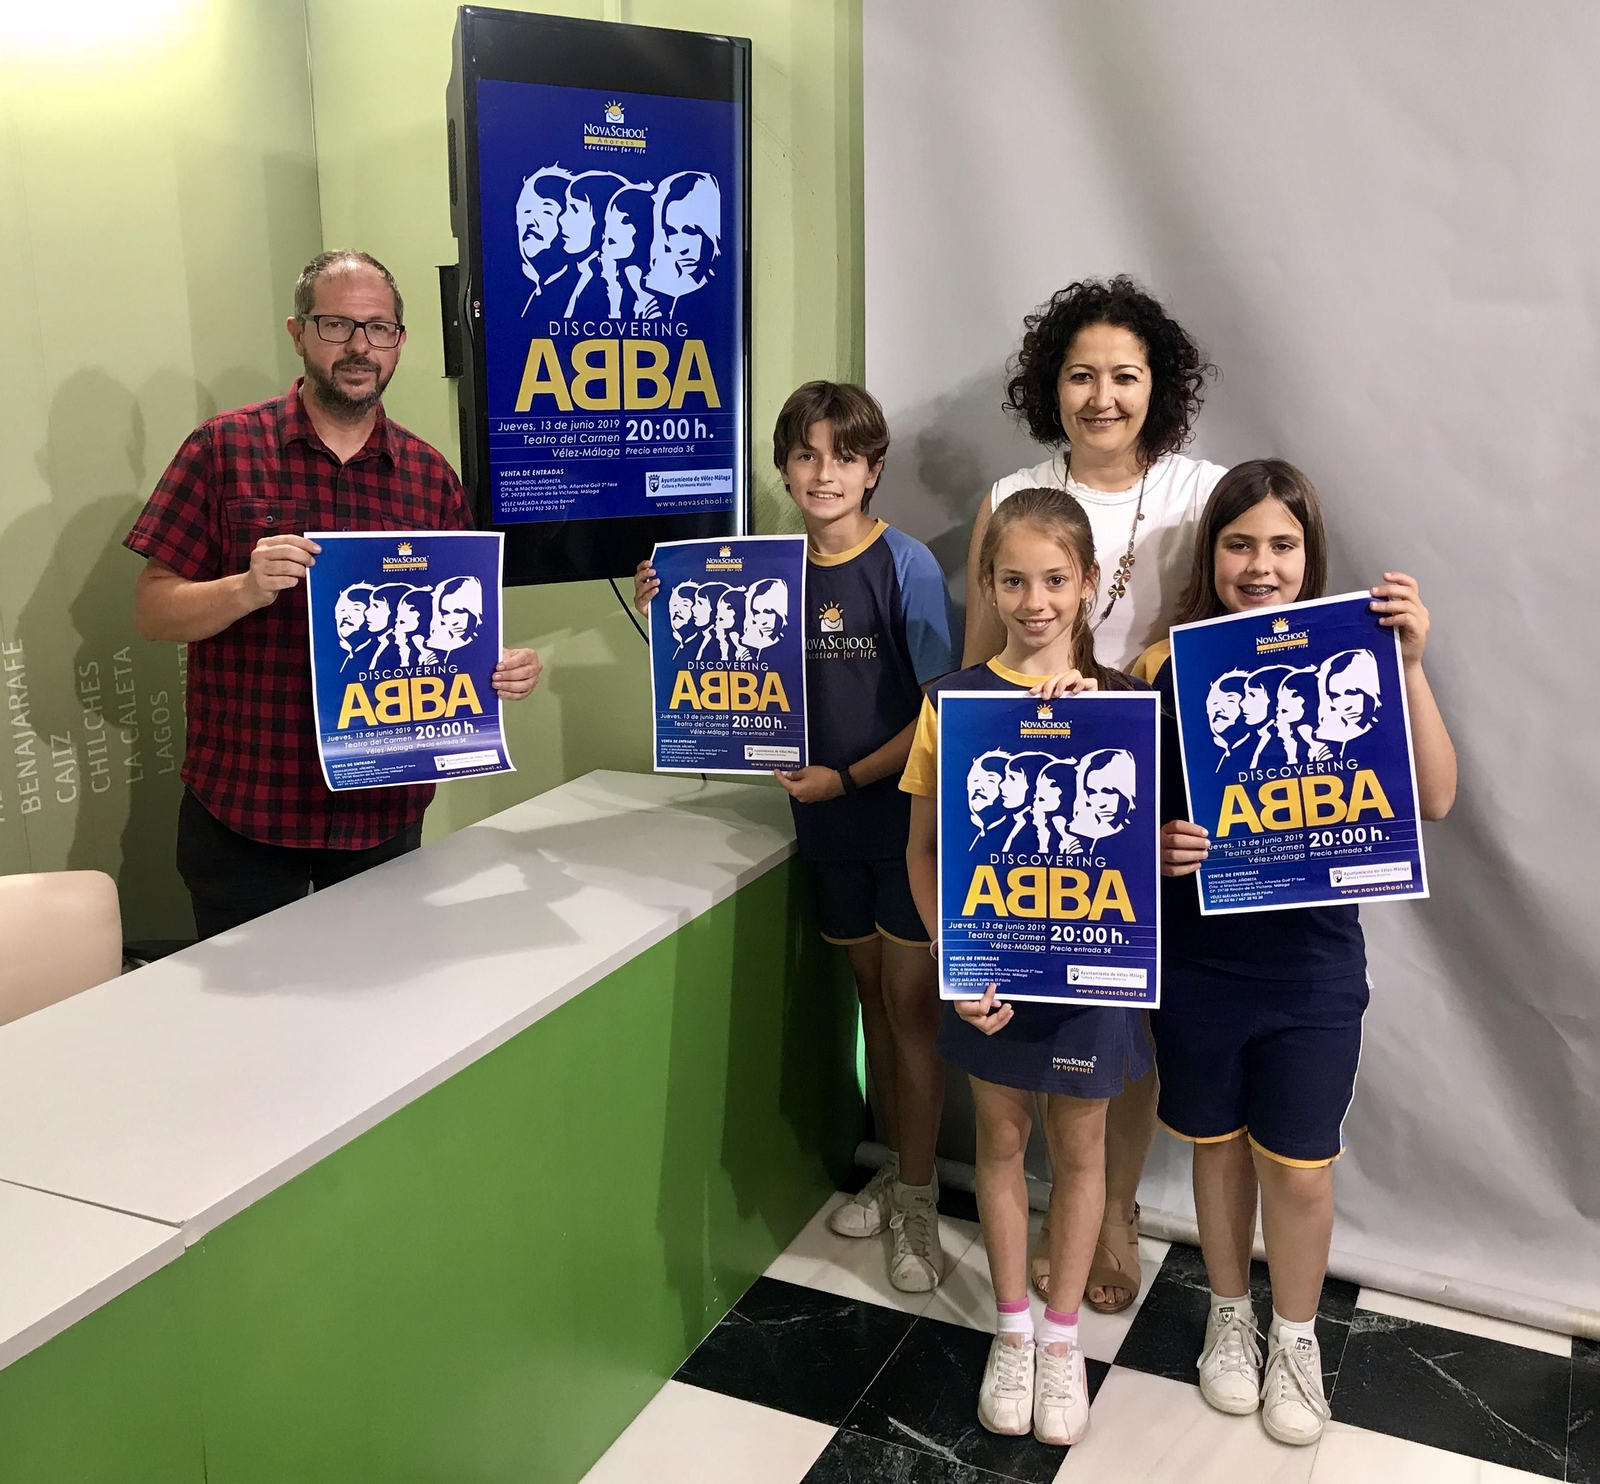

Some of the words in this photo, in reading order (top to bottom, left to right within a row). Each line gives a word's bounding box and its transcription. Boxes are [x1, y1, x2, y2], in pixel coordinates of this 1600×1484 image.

[584, 144, 618, 152] education
[621, 146, 632, 154] for
[550, 321, 689, 337] DISCOVERING
[514, 339, 722, 412] ABBA
[498, 421, 536, 432] Jueves,
[541, 421, 552, 430] 13
[554, 420, 568, 430] de
[570, 420, 595, 432] junio
[598, 419, 620, 430] 2019
[625, 418, 690, 441] 20:00
[694, 418, 715, 439] h.
[523, 434, 557, 445] Teatro
[560, 434, 577, 444] del
[580, 434, 620, 444] Carmen
[552, 447, 620, 460] Vélez-Málaga
[625, 446, 650, 455] Precio
[652, 445, 684, 454] entrada
[686, 444, 695, 453] 3€
[532, 468, 564, 476] ENTRADAS
[661, 476, 693, 484] Ayuntamiento
[656, 497, 733, 508] www.novaschool.es
[805, 634, 876, 650] OVASCHOOL
[843, 650, 854, 660] for
[860, 649, 877, 660] life
[358, 664, 459, 682] DISCOVERING
[688, 661, 769, 671] DISCOVERING
[113, 646, 140, 744] CALETA
[669, 670, 791, 712] ABBA
[337, 673, 484, 730] ABBA
[2, 638, 41, 814] BENAJARAFE
[79, 661, 110, 793] CHILCHES
[732, 715, 772, 729] 20:00
[774, 716, 788, 730] h.
[1020, 720, 1071, 728] NOVASCHOOL
[151, 690, 174, 774] LAGOS
[326, 734, 353, 742] Jueves,
[366, 730, 375, 738] de
[376, 728, 394, 738] junio
[396, 726, 411, 734] 2019
[415, 722, 462, 740] 20:00
[464, 720, 480, 734] h.
[690, 728, 730, 736] Vélez-Málaga
[344, 740, 368, 749] Teatro
[370, 738, 382, 746] del
[384, 736, 412, 745] Carmen
[366, 744, 414, 755] Vélez-Málaga
[436, 738, 459, 748] entrada
[51, 730, 77, 803] CAJIZ
[124, 751, 144, 784] LA
[1238, 758, 1359, 783] DISCOVERING
[1216, 768, 1396, 838] ABBA
[1208, 842, 1234, 850] ueves,
[1238, 840, 1246, 848] 13
[1248, 838, 1260, 846] de
[1262, 836, 1282, 846] junio
[1284, 833, 1304, 842] 2019
[1308, 828, 1367, 848] 20:00
[1370, 826, 1390, 842] h.
[1224, 848, 1252, 858] Teatro
[1254, 846, 1268, 854] del
[1270, 843, 1304, 853] Carmen
[1310, 850, 1332, 858] Precio
[1334, 846, 1362, 856] entrada
[990, 854, 1107, 868] DISCOVERING
[1248, 852, 1306, 864] Vélez-Málaga
[962, 864, 1137, 923] ABBA
[1341, 883, 1414, 894] www.novaschool.es
[948, 921, 978, 930] Jueves,
[981, 922, 990, 930] 13
[992, 922, 1003, 930] de
[1004, 922, 1025, 932] junio
[1027, 924, 1046, 932] 2019
[967, 932, 995, 940] Teatro
[996, 932, 1010, 940] del
[1012, 932, 1046, 942] Carmen
[1050, 925, 1108, 944] 20:00
[1112, 926, 1130, 945] h.
[990, 942, 1046, 952] Vélez-Málaga
[1050, 945, 1072, 953] Precio
[1074, 946, 1102, 954] entrada
[1076, 988, 1147, 998] www.novaschool.es
